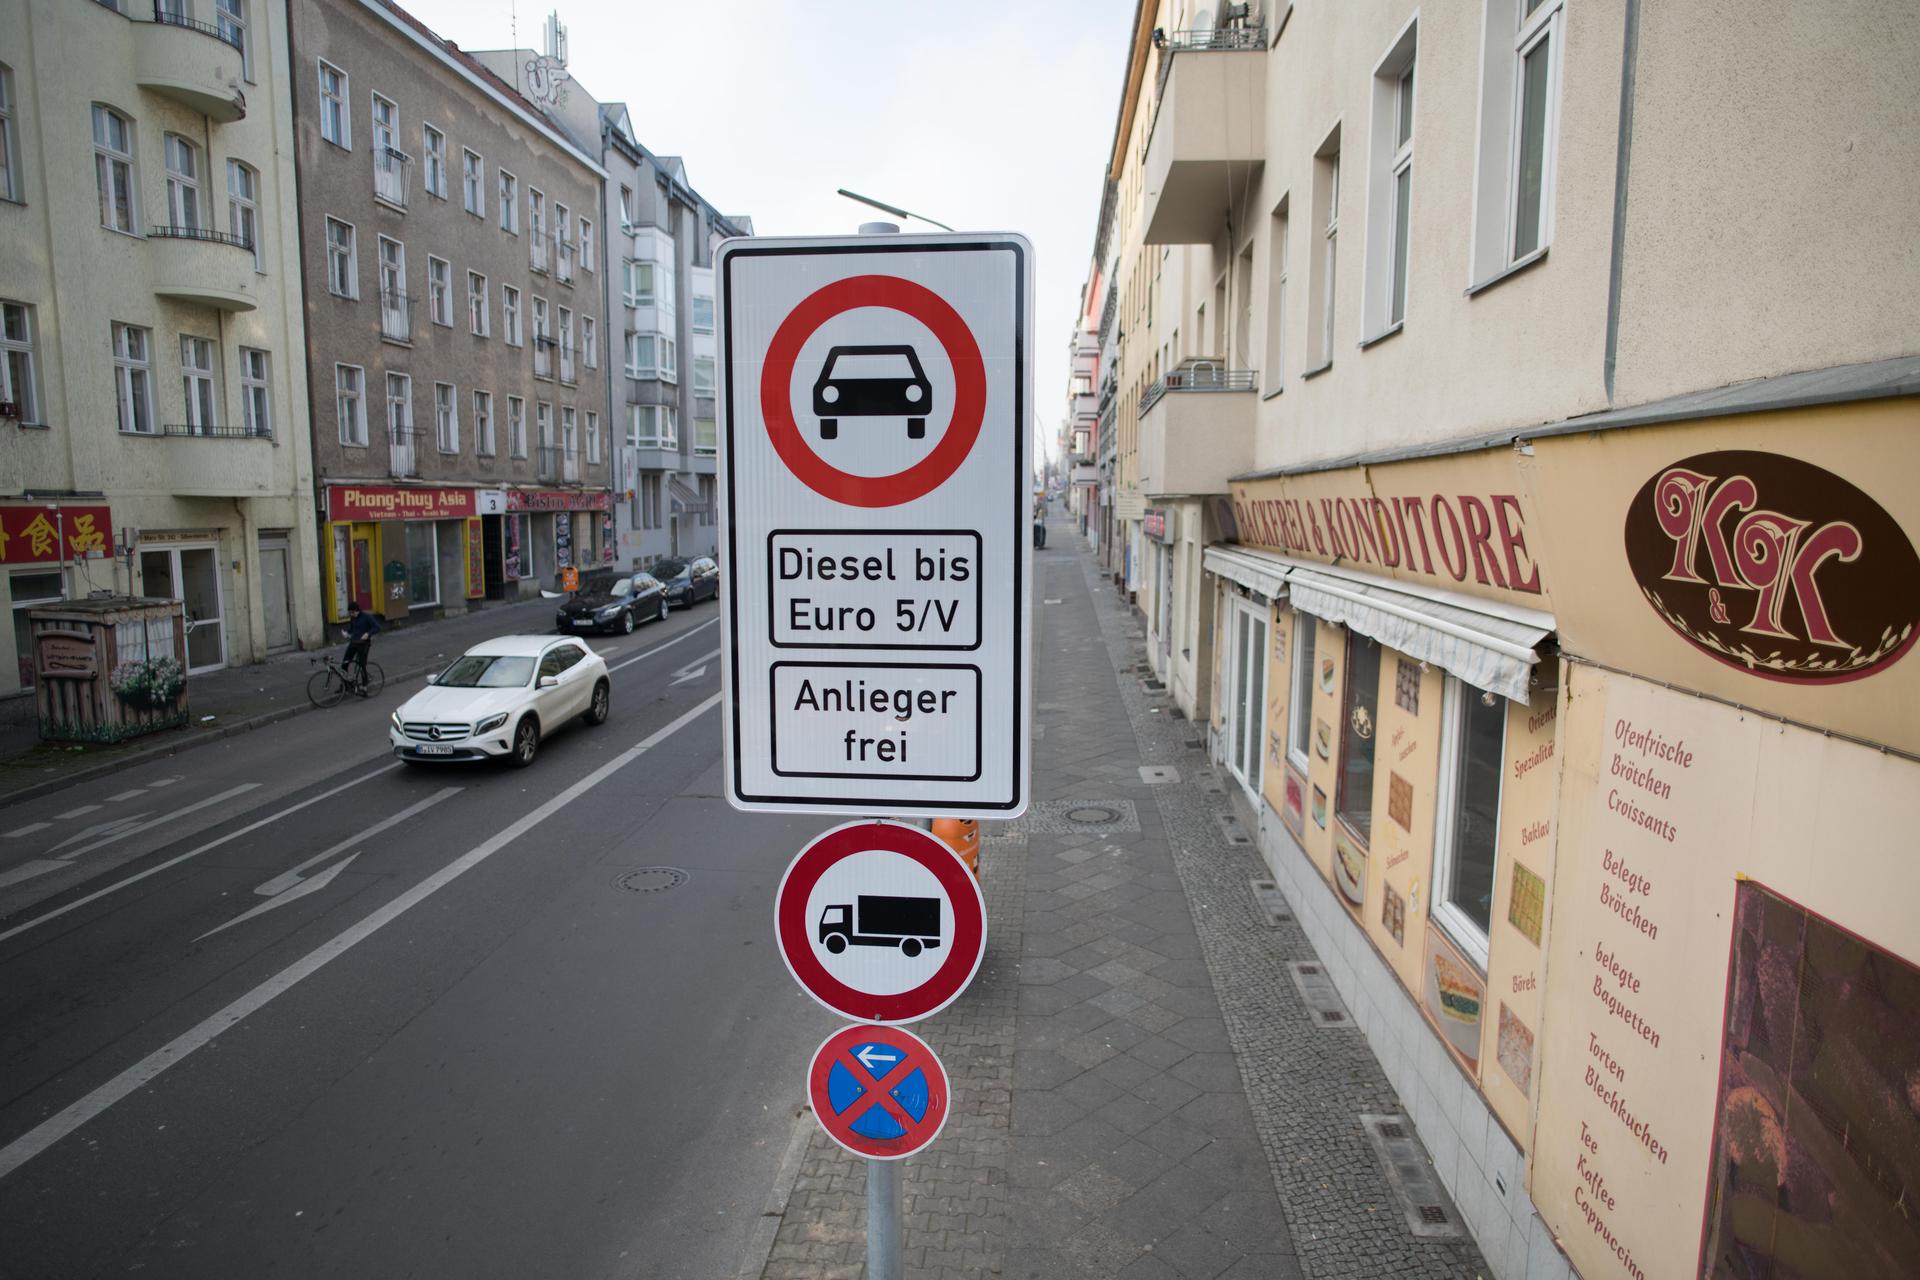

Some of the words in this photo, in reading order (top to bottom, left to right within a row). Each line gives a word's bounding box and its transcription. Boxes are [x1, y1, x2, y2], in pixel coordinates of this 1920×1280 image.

[344, 490, 433, 510] Phong-Thuy
[438, 491, 466, 506] Asia
[490, 499, 496, 510] 3
[0, 513, 106, 560] 食品
[1306, 500, 1328, 555] &
[1320, 494, 1542, 595] KONDITORE
[779, 547, 896, 581] Diesel
[916, 548, 970, 581] bis
[790, 598, 876, 632] Euro
[896, 599, 959, 632] 5/V
[793, 679, 957, 722] Anlieger
[844, 729, 907, 762] frei
[1514, 738, 1556, 780] Spezialitä
[1615, 719, 1693, 768] Ofenfrische
[1611, 752, 1672, 800] Brötchen
[1608, 788, 1677, 843] Croissants
[1602, 848, 1651, 897] Belegte
[1600, 882, 1658, 940] Brötchen
[1512, 971, 1536, 993] Börek
[1595, 941, 1640, 994] belegte
[1592, 974, 1660, 1048] Baguetten
[1589, 1032, 1625, 1083] Torten
[1580, 1120, 1598, 1155] Tee
[1585, 1065, 1668, 1165] Blechkuchen
[1577, 1154, 1615, 1212] Kaffee
